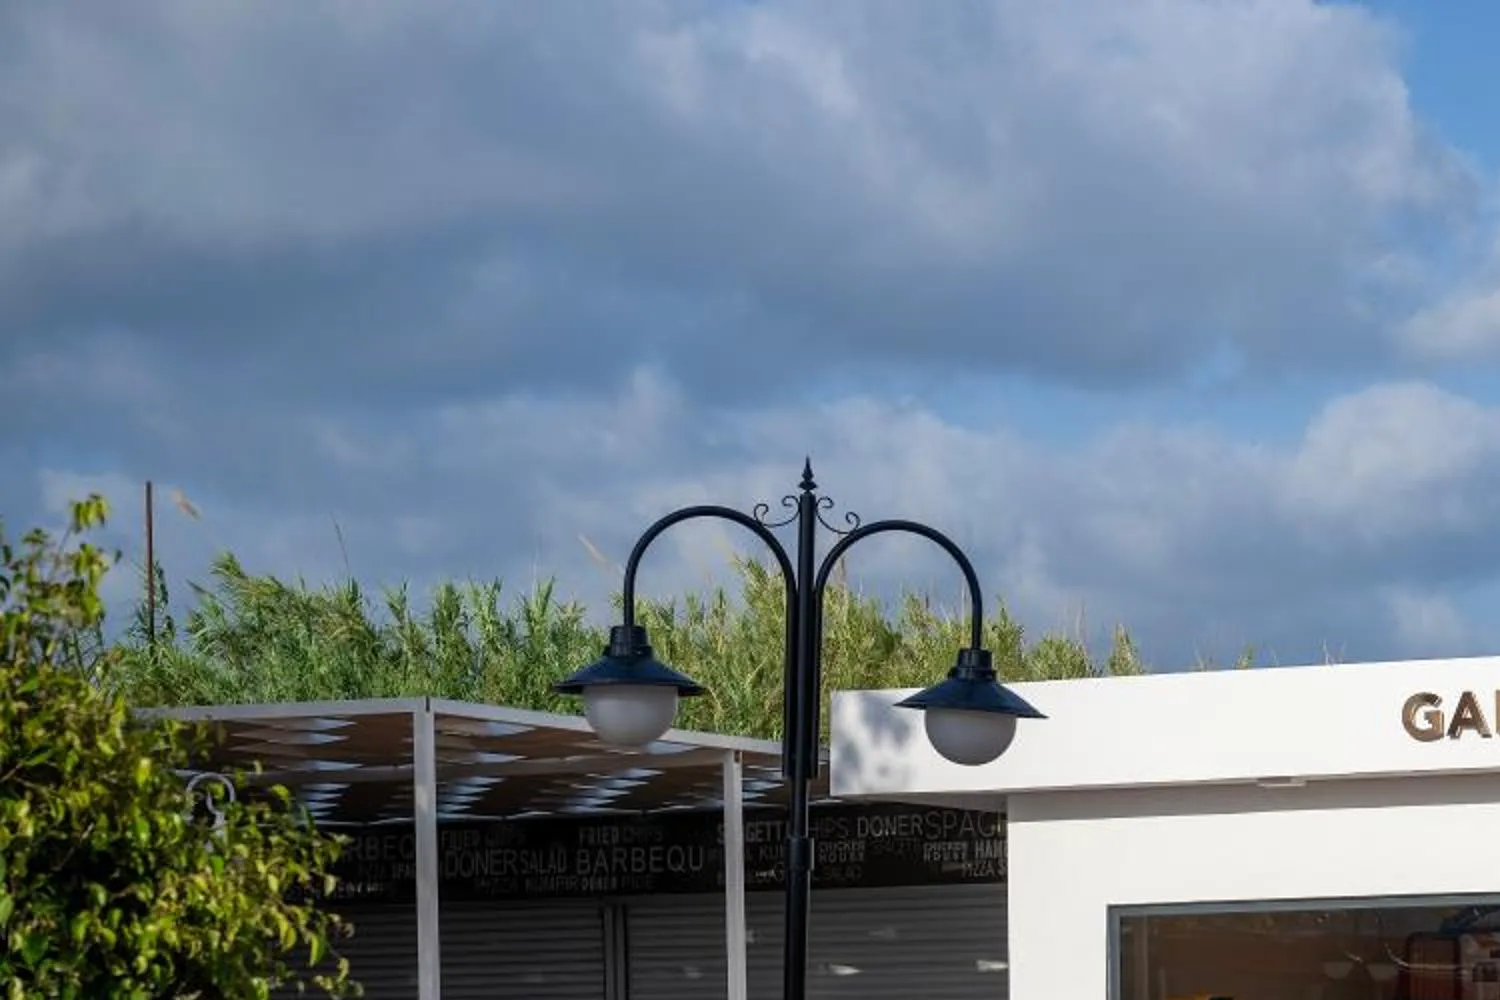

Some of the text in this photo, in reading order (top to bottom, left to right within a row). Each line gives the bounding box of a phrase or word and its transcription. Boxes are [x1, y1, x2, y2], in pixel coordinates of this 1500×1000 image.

[857, 813, 923, 838] DONER
[924, 809, 1003, 841] SPAG
[445, 848, 519, 880] DONER
[520, 844, 567, 875] SALAD
[577, 844, 704, 877] BARBEQU
